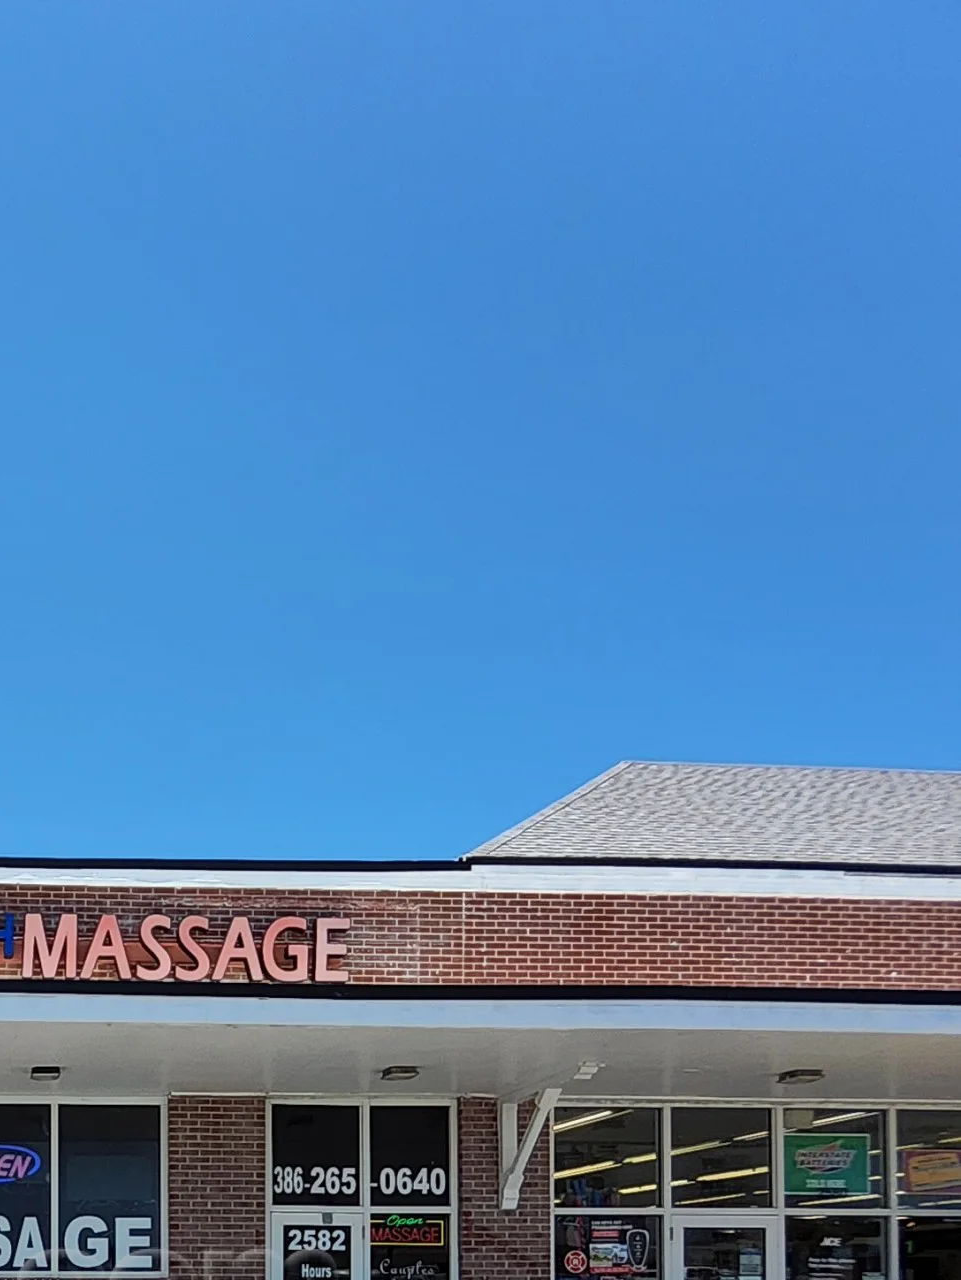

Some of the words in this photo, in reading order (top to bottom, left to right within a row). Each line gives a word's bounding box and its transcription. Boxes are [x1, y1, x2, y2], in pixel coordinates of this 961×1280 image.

[21, 912, 351, 983] MASSAGE
[386, 1214, 424, 1227] Open
[288, 1229, 346, 1251] 2582
[371, 1227, 440, 1241] MASSAGE
[301, 1263, 332, 1278] Hours
